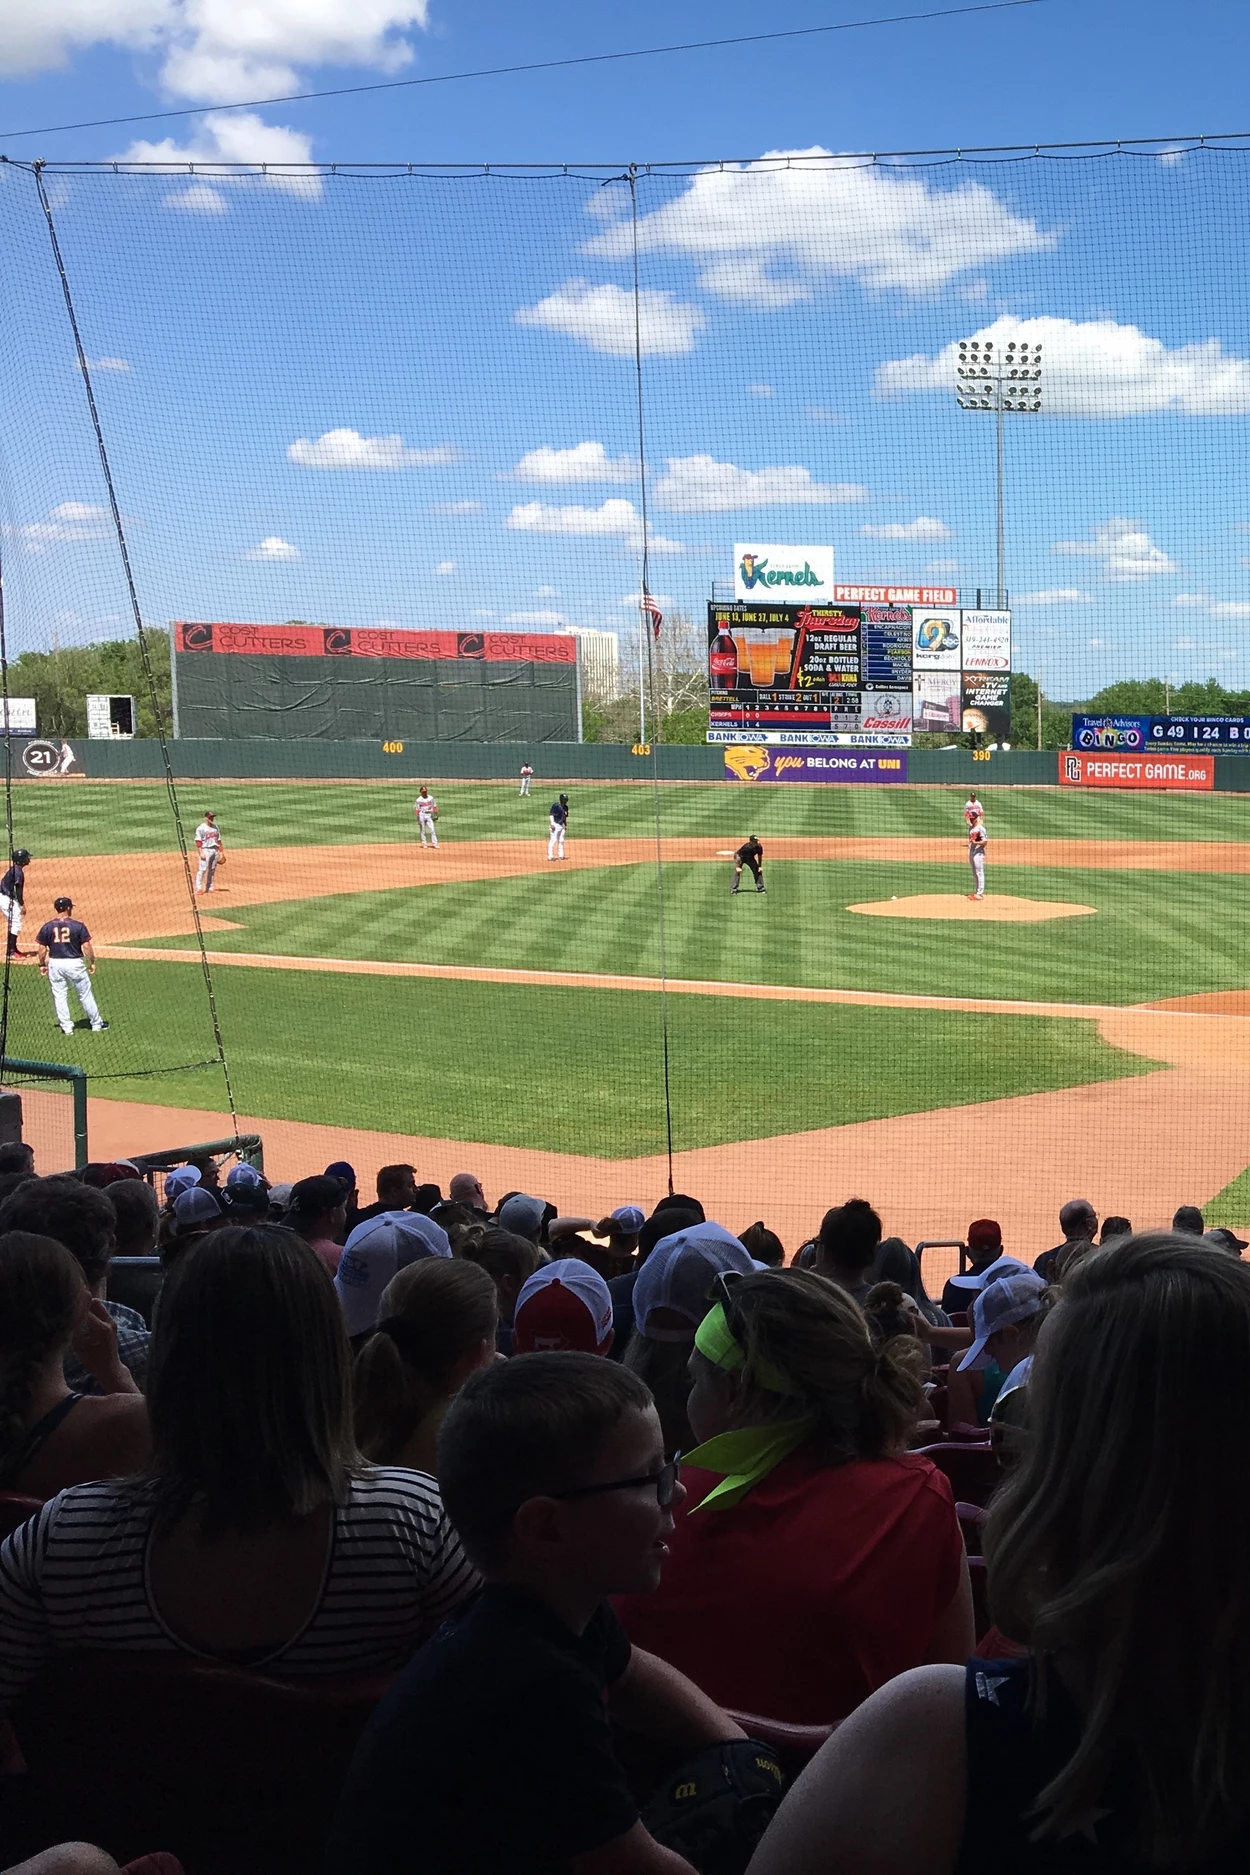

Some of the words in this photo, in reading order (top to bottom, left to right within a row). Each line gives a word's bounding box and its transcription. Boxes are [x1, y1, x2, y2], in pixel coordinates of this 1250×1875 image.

[740, 556, 824, 589] Kernels
[837, 586, 885, 601] PERFECT
[887, 587, 920, 601] GAME
[922, 588, 954, 603] FIELD
[715, 612, 730, 621] JUNE
[732, 612, 740, 622] 13,
[742, 612, 757, 622] JUNE
[758, 613, 768, 623] 27,
[769, 613, 783, 622] JULY
[784, 613, 789, 622] 4
[812, 609, 843, 617] THIRSTY
[965, 615, 1008, 624] Affordable
[219, 626, 258, 636] COST
[357, 631, 395, 641] COST
[219, 636, 307, 650] CUTTERS
[488, 634, 527, 645] COST
[805, 634, 822, 643] 12oz
[823, 634, 857, 643] REGULAR
[357, 641, 441, 653] CUTTERS
[489, 644, 569, 657] CUTTERS
[814, 643, 837, 651] DRAFT
[839, 643, 857, 651] BEER
[809, 655, 827, 664] 20oz
[828, 656, 859, 664] BOTTLED
[965, 657, 1000, 667] LENNOX
[803, 664, 824, 672] SODA
[825, 664, 832, 672] &
[834, 664, 859, 673] WATER
[796, 666, 815, 688] $2
[964, 675, 1009, 685] XTREAM
[771, 693, 777, 702] 1
[778, 693, 796, 701] STRIKE
[795, 693, 802, 702] 2
[812, 693, 818, 702] 1
[863, 716, 911, 729] Cassill
[1082, 717, 1103, 727] Travel
[1111, 718, 1141, 728] Advisors
[708, 733, 737, 742] BANK
[737, 733, 768, 742] IOWA
[1153, 725, 1164, 737] G
[1167, 725, 1184, 738] 49
[1193, 727, 1198, 738] I
[1202, 727, 1220, 739] 24
[1229, 727, 1239, 739] B
[780, 734, 808, 743] BANK
[809, 734, 839, 743] IOWA
[850, 735, 879, 744] BANK
[879, 735, 909, 744] IOWA
[1079, 729, 1140, 747] BINGO
[382, 741, 403, 753] 400
[631, 744, 651, 755] 403
[30, 750, 51, 764] 21
[972, 750, 991, 761] 390
[774, 756, 805, 777] you
[806, 757, 857, 769] BELONG
[859, 758, 876, 769] AT
[877, 758, 901, 769] UNI
[1086, 762, 1143, 779] PERFECT
[1145, 763, 1207, 781] GAME.ORG
[52, 926, 71, 943] 12
